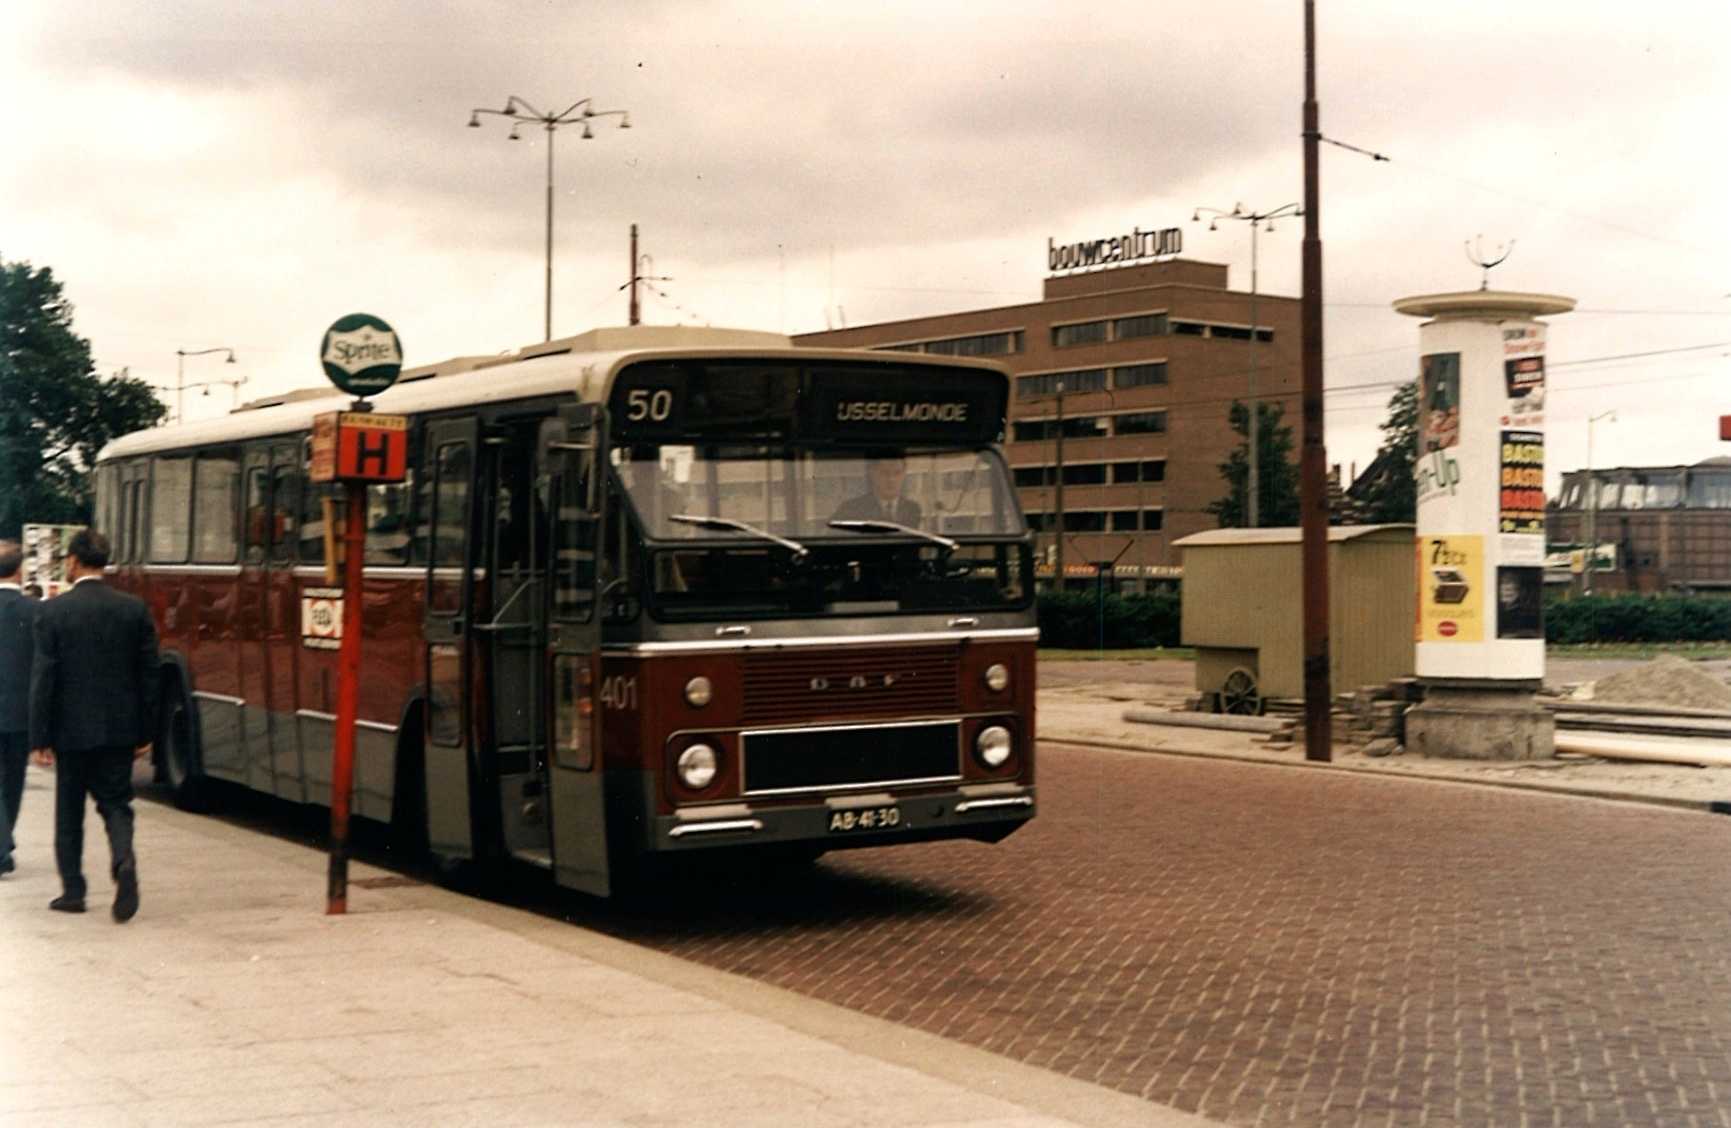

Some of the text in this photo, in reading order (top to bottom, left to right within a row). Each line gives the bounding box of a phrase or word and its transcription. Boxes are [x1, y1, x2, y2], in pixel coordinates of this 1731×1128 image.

[1049, 227, 1181, 271] bouwcentrum
[334, 336, 390, 364] Sprite
[627, 389, 672, 421] 50
[356, 431, 390, 475] H
[600, 676, 638, 710] 401
